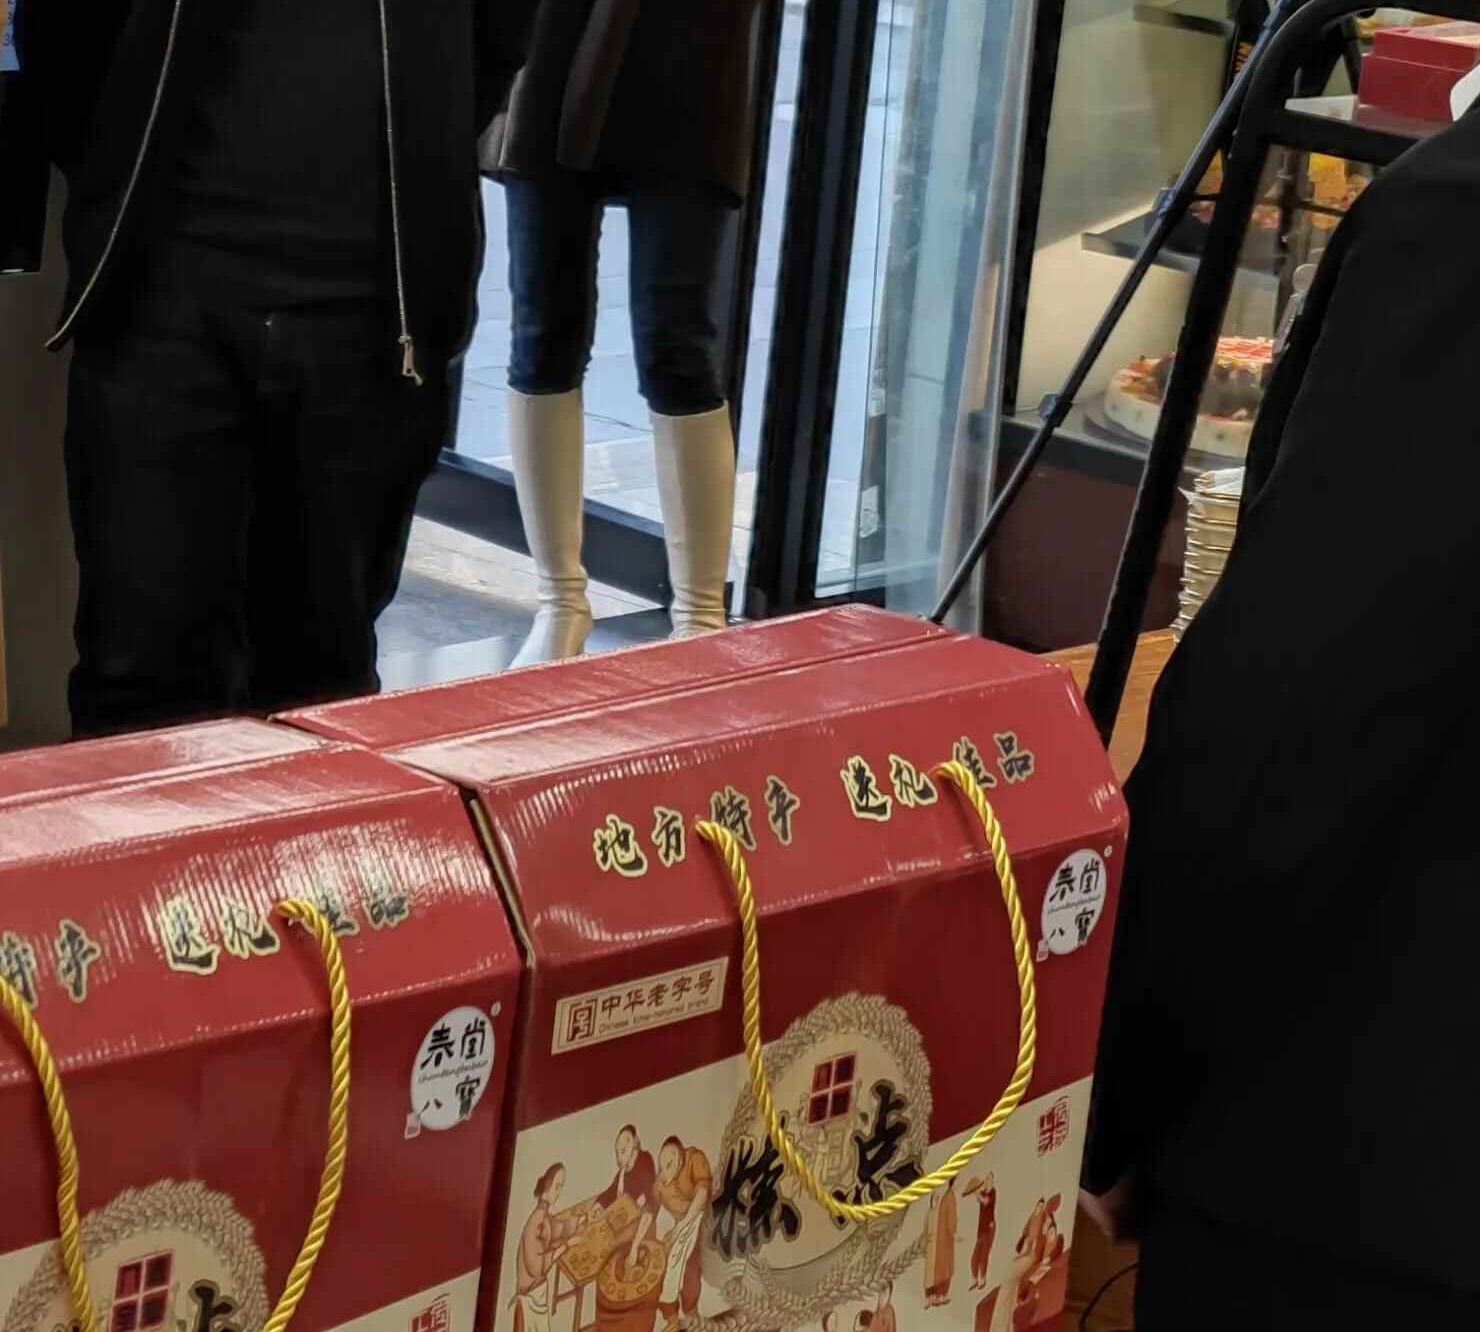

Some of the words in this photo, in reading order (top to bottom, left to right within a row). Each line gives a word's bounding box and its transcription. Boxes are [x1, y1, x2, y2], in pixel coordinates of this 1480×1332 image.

[601, 968, 716, 1020] 中华老字号
